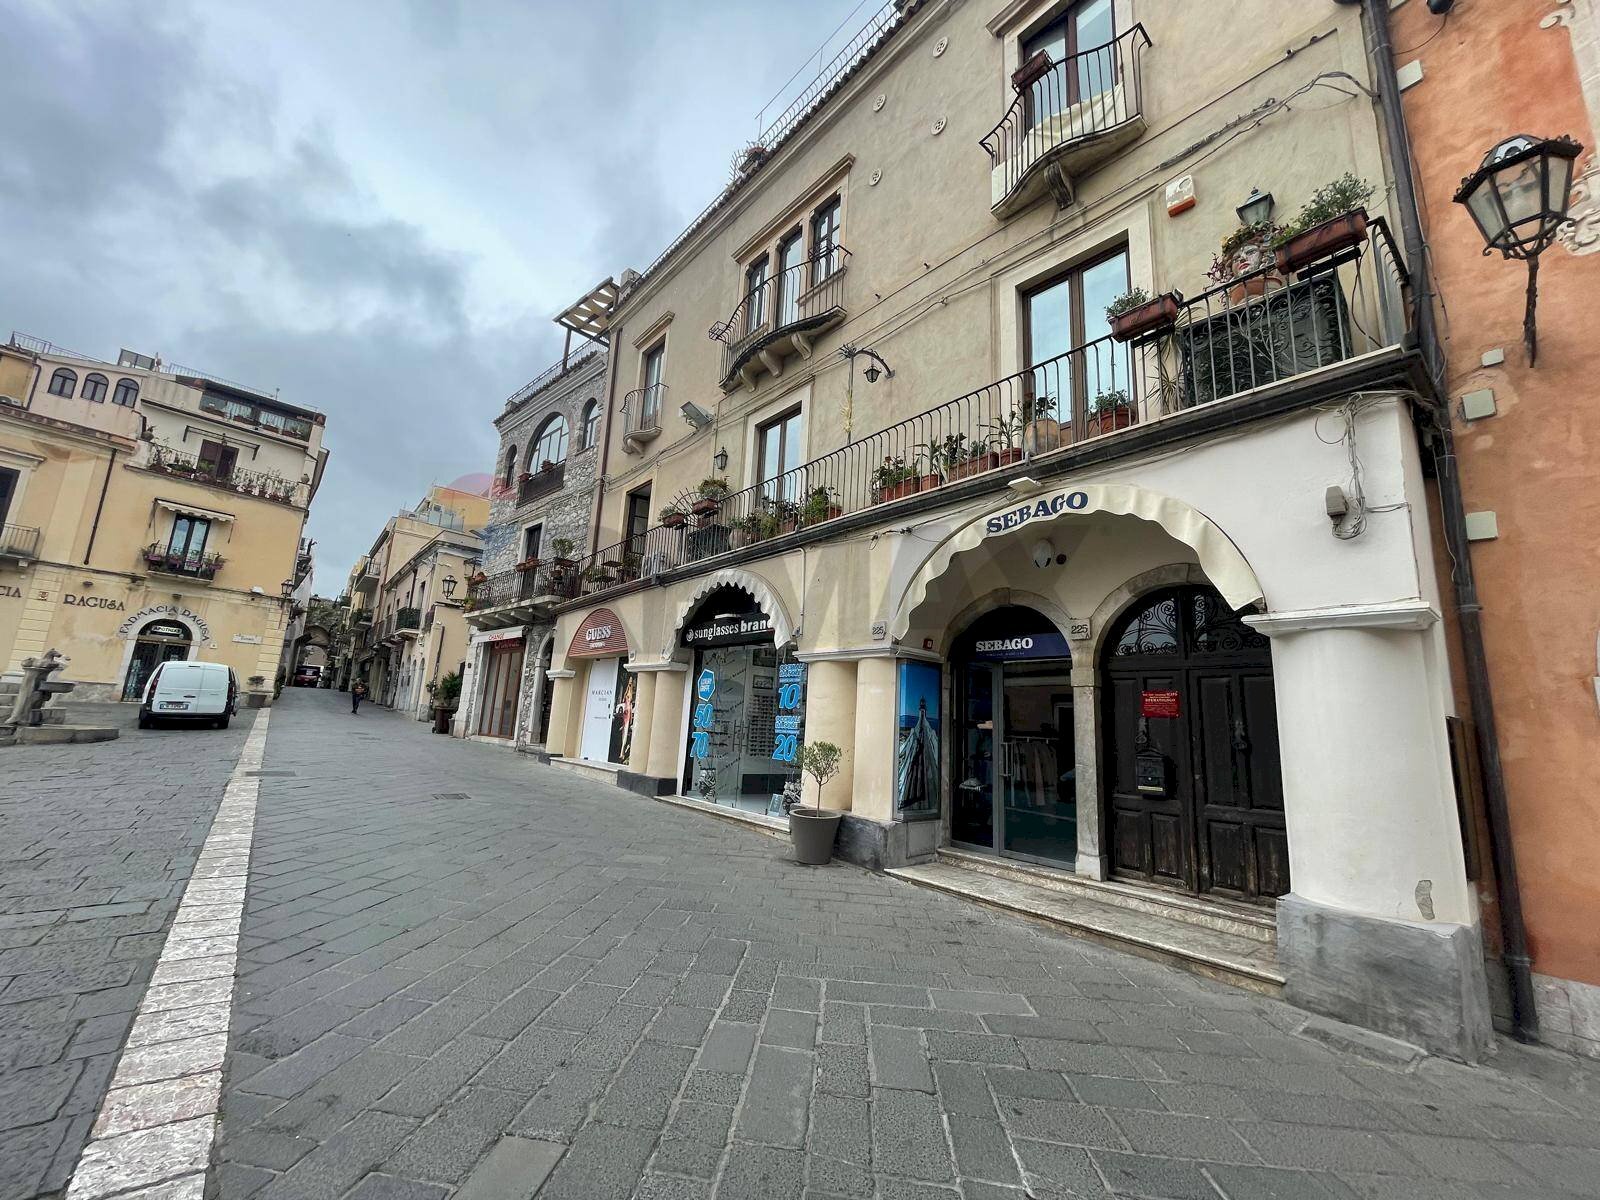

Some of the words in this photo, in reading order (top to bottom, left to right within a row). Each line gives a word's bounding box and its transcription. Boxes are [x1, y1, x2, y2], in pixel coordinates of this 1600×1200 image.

[986, 491, 1089, 535] SEBAGO
[63, 594, 126, 611] RAGUSA
[586, 625, 612, 641] GUESS
[694, 623, 739, 640] sunglasses
[741, 620, 769, 632] bran
[1071, 624, 1088, 635] 225
[976, 637, 1033, 652] SEBAGO
